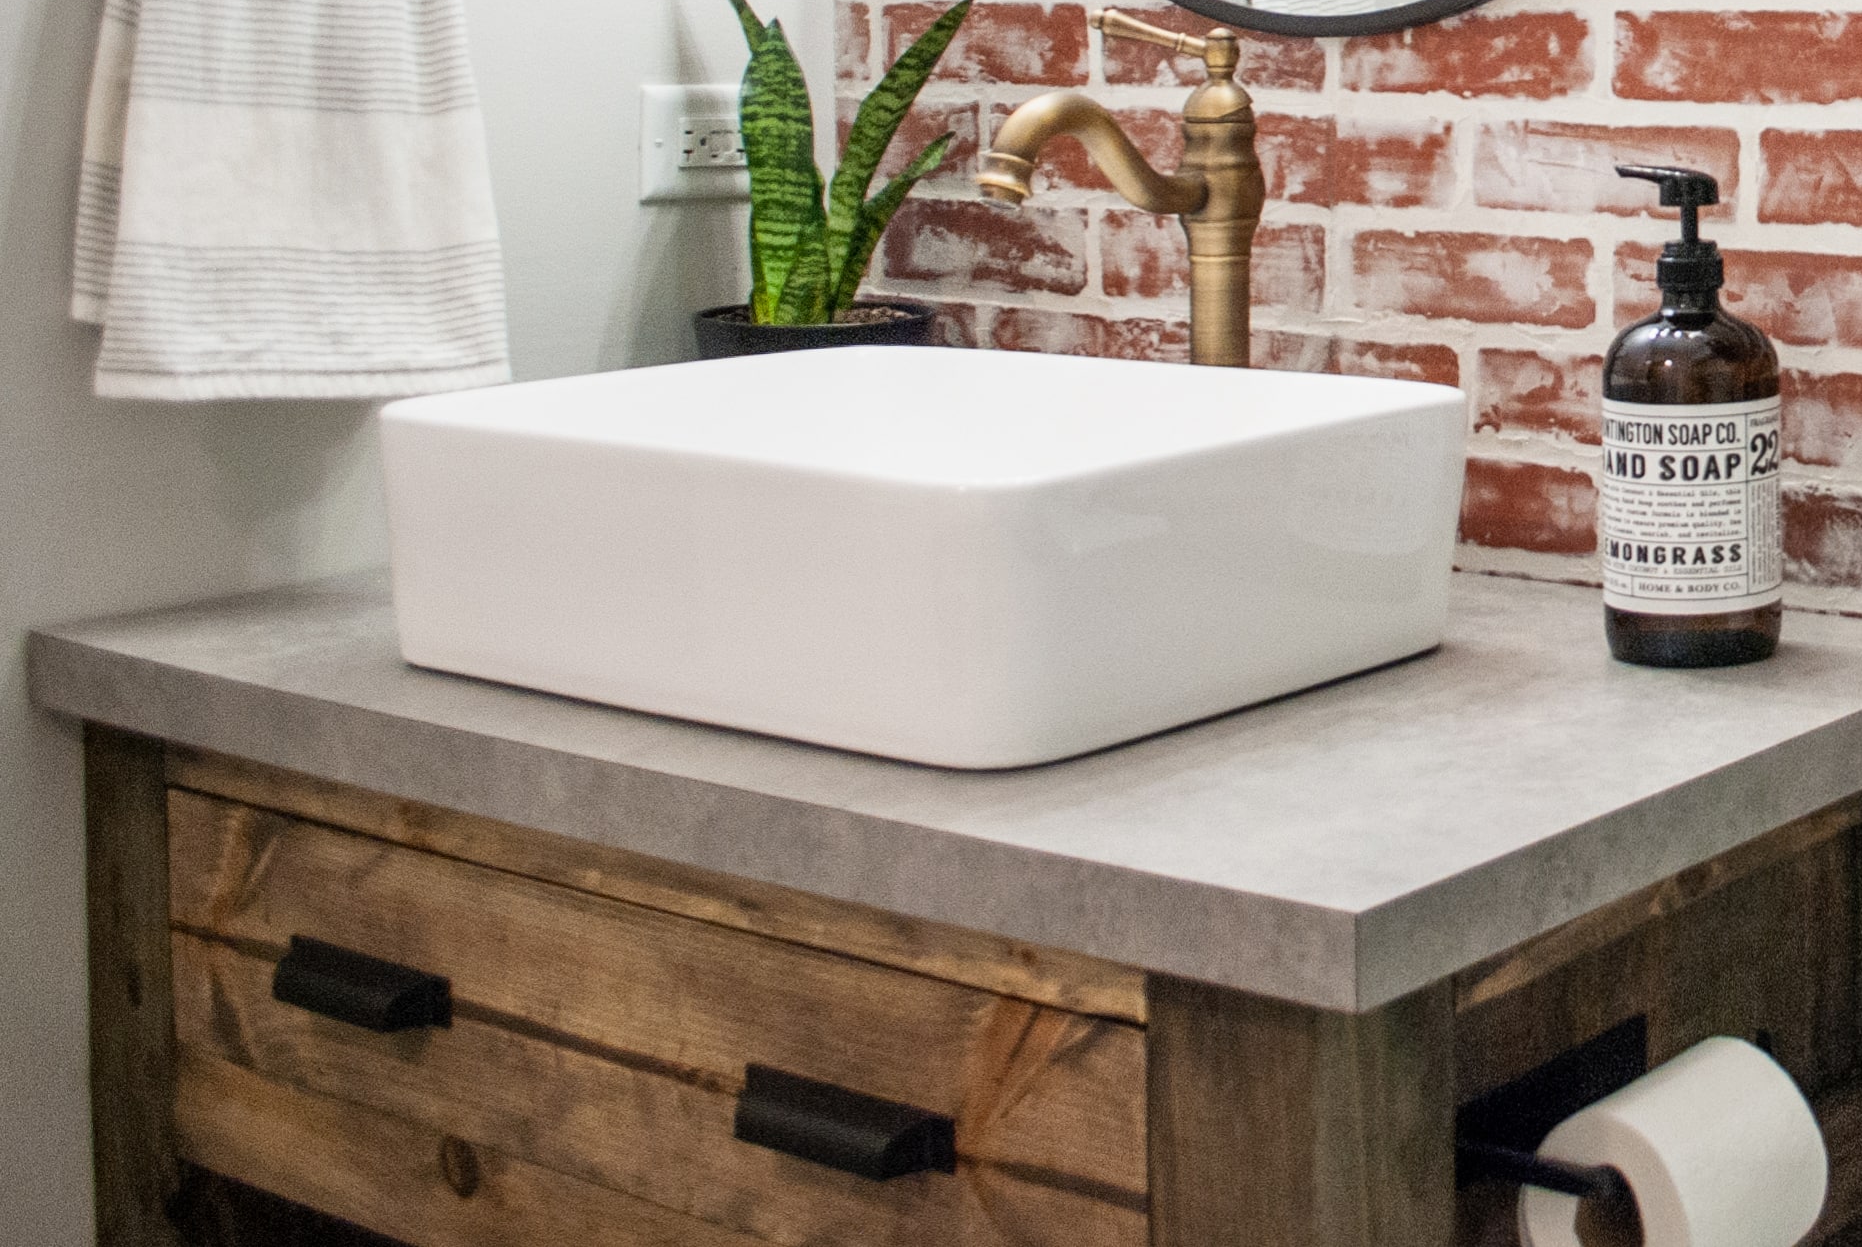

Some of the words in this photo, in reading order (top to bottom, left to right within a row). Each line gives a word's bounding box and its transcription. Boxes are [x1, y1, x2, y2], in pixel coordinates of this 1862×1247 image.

[1668, 423, 1713, 446] SOAP
[1716, 422, 1741, 444] CO.
[1602, 447, 1645, 479] AND
[1659, 453, 1742, 481] SOAP
[1750, 429, 1779, 476] 22
[1638, 582, 1671, 593] HOME
[1674, 585, 1683, 593] &
[1687, 583, 1720, 593] BODY
